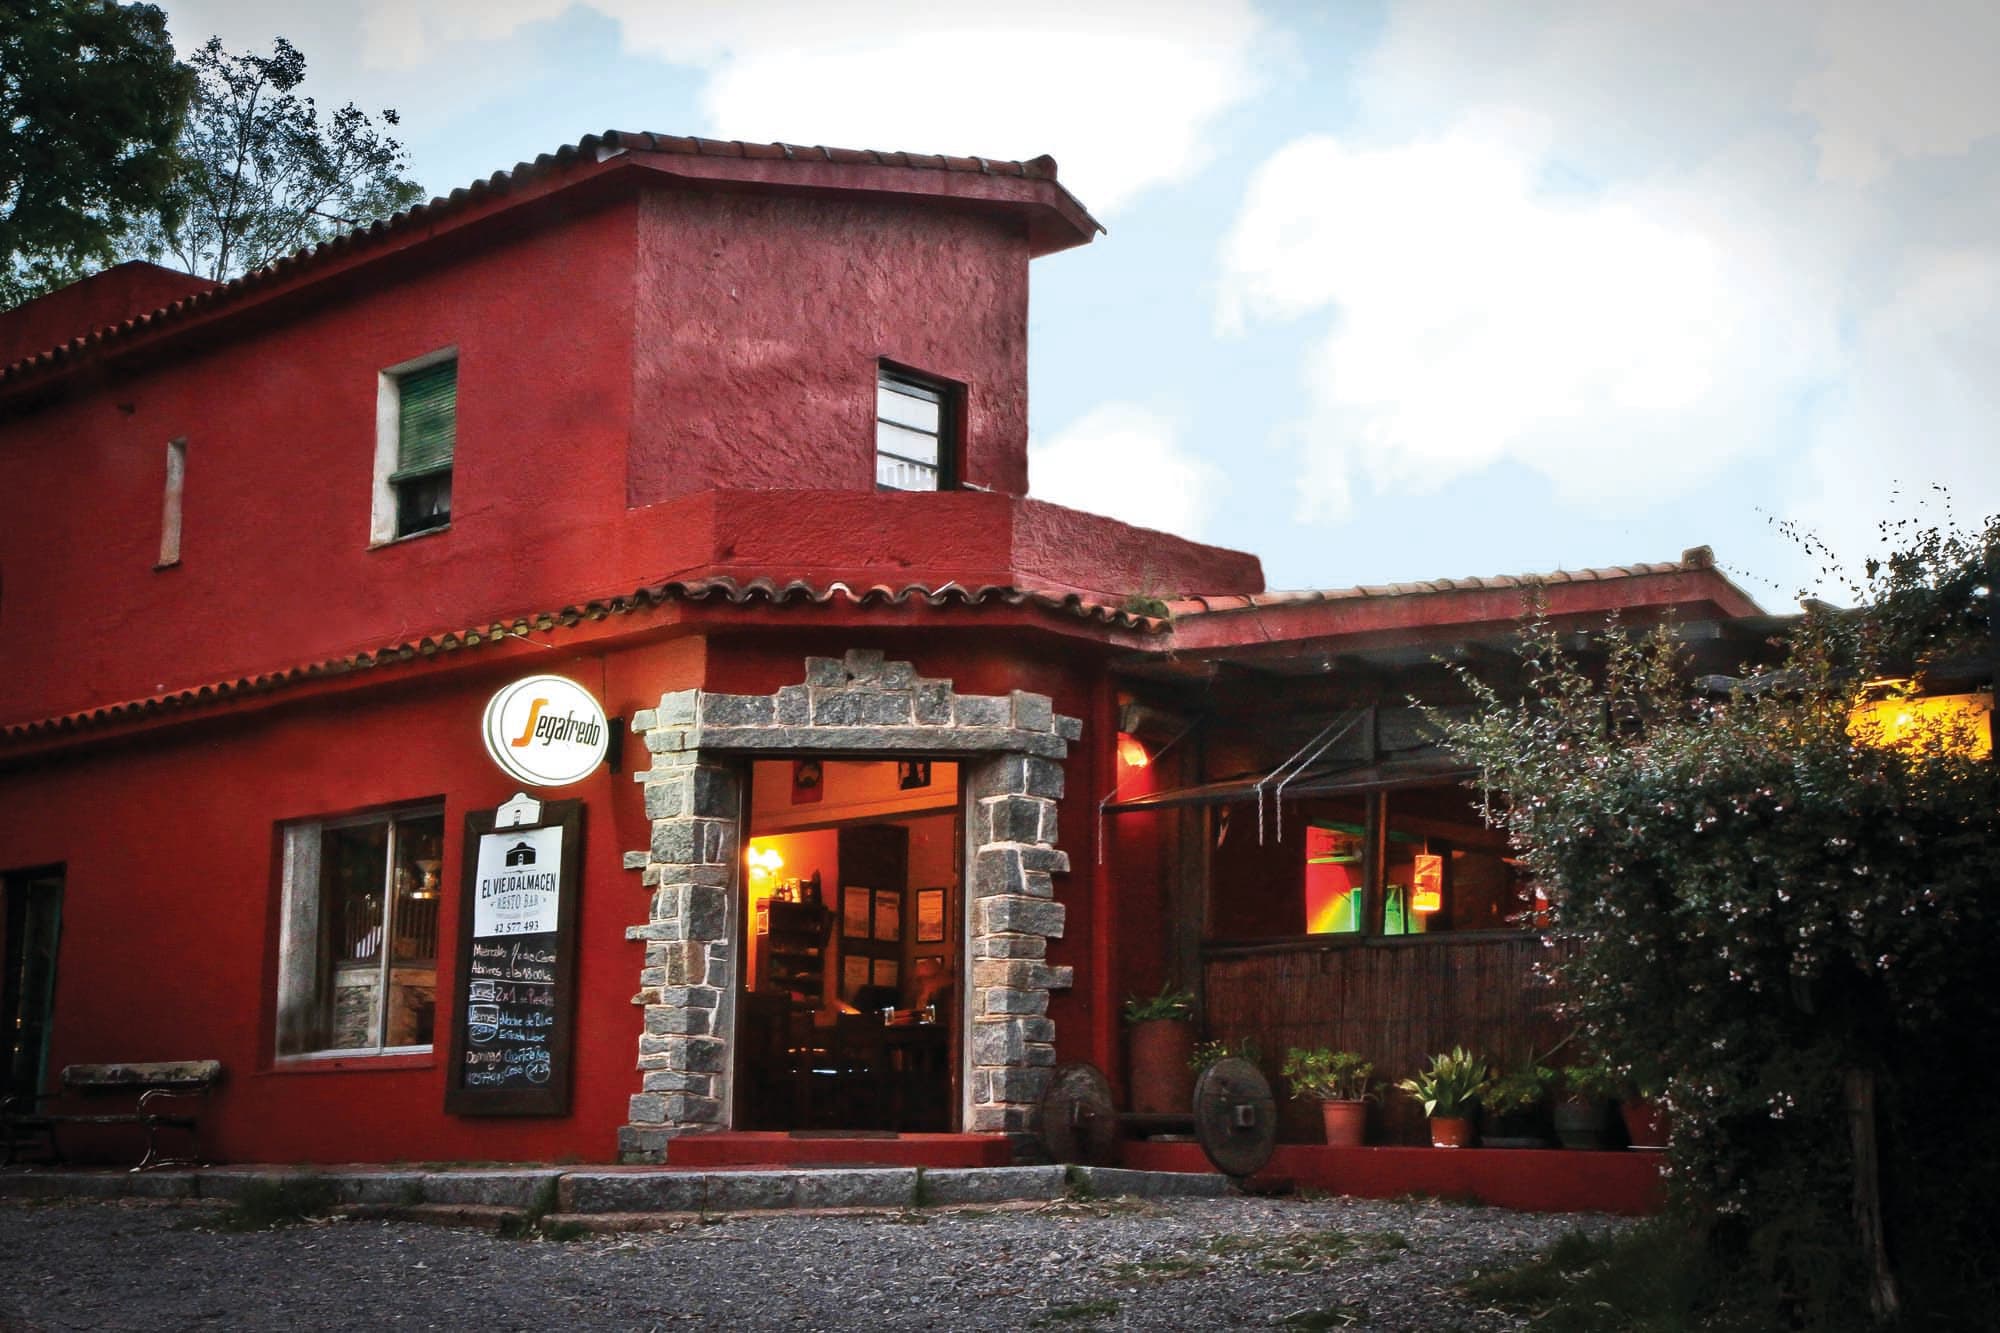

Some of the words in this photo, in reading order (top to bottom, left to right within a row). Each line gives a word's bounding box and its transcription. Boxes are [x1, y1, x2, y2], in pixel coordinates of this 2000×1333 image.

[511, 698, 601, 748] Segafredo
[482, 879, 492, 898] EL
[493, 876, 516, 895] VIEJO
[516, 872, 556, 892] ALMACEN
